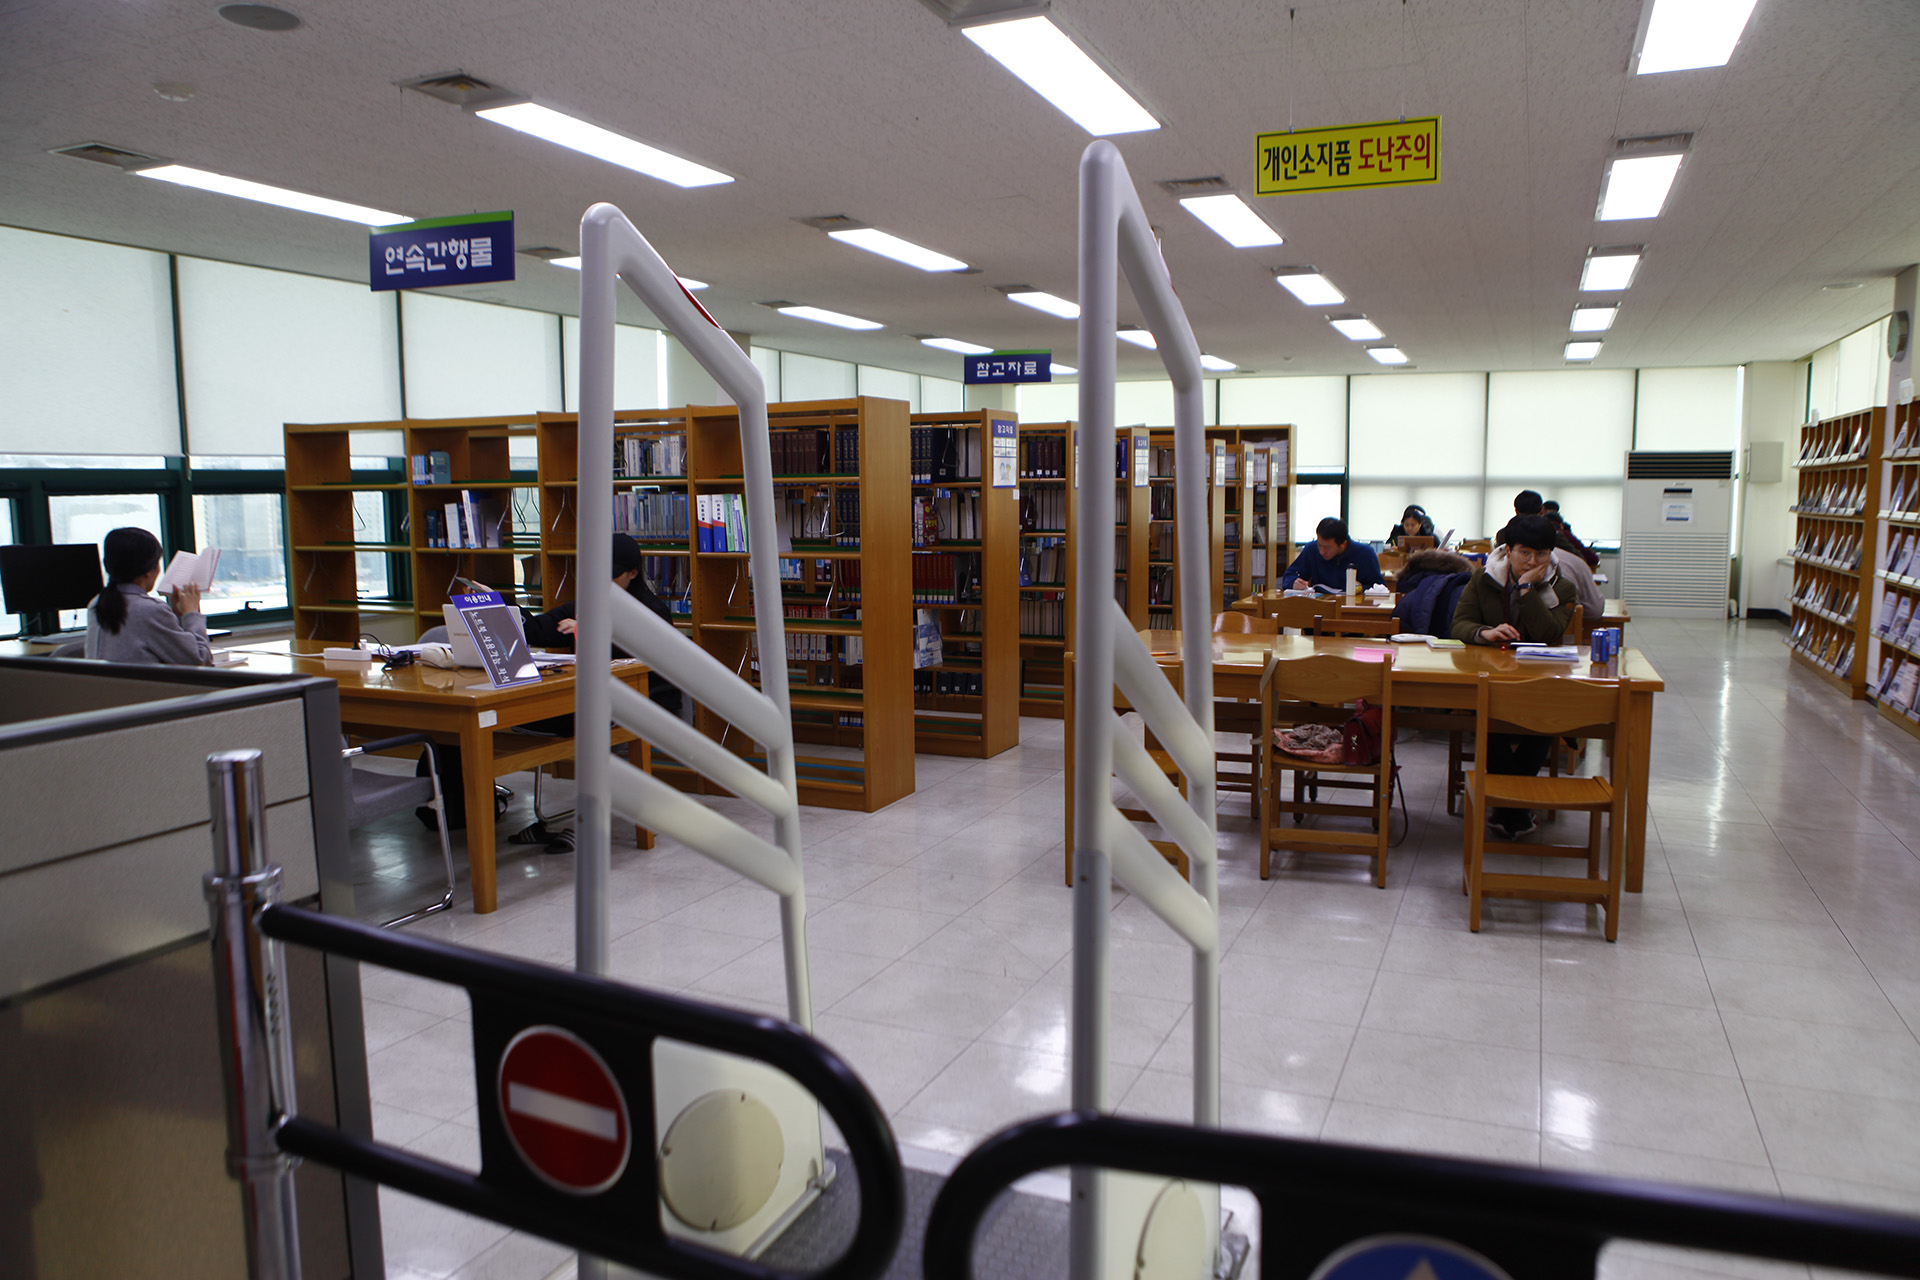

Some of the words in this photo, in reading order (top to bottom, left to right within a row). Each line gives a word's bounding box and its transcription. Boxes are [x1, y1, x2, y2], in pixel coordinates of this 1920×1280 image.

[1263, 140, 1351, 181] 개인소지품
[1358, 132, 1431, 172] 도난주의
[385, 237, 492, 275] 연속간행물
[976, 361, 1037, 378] 참고자료
[464, 594, 492, 604] 이용안내
